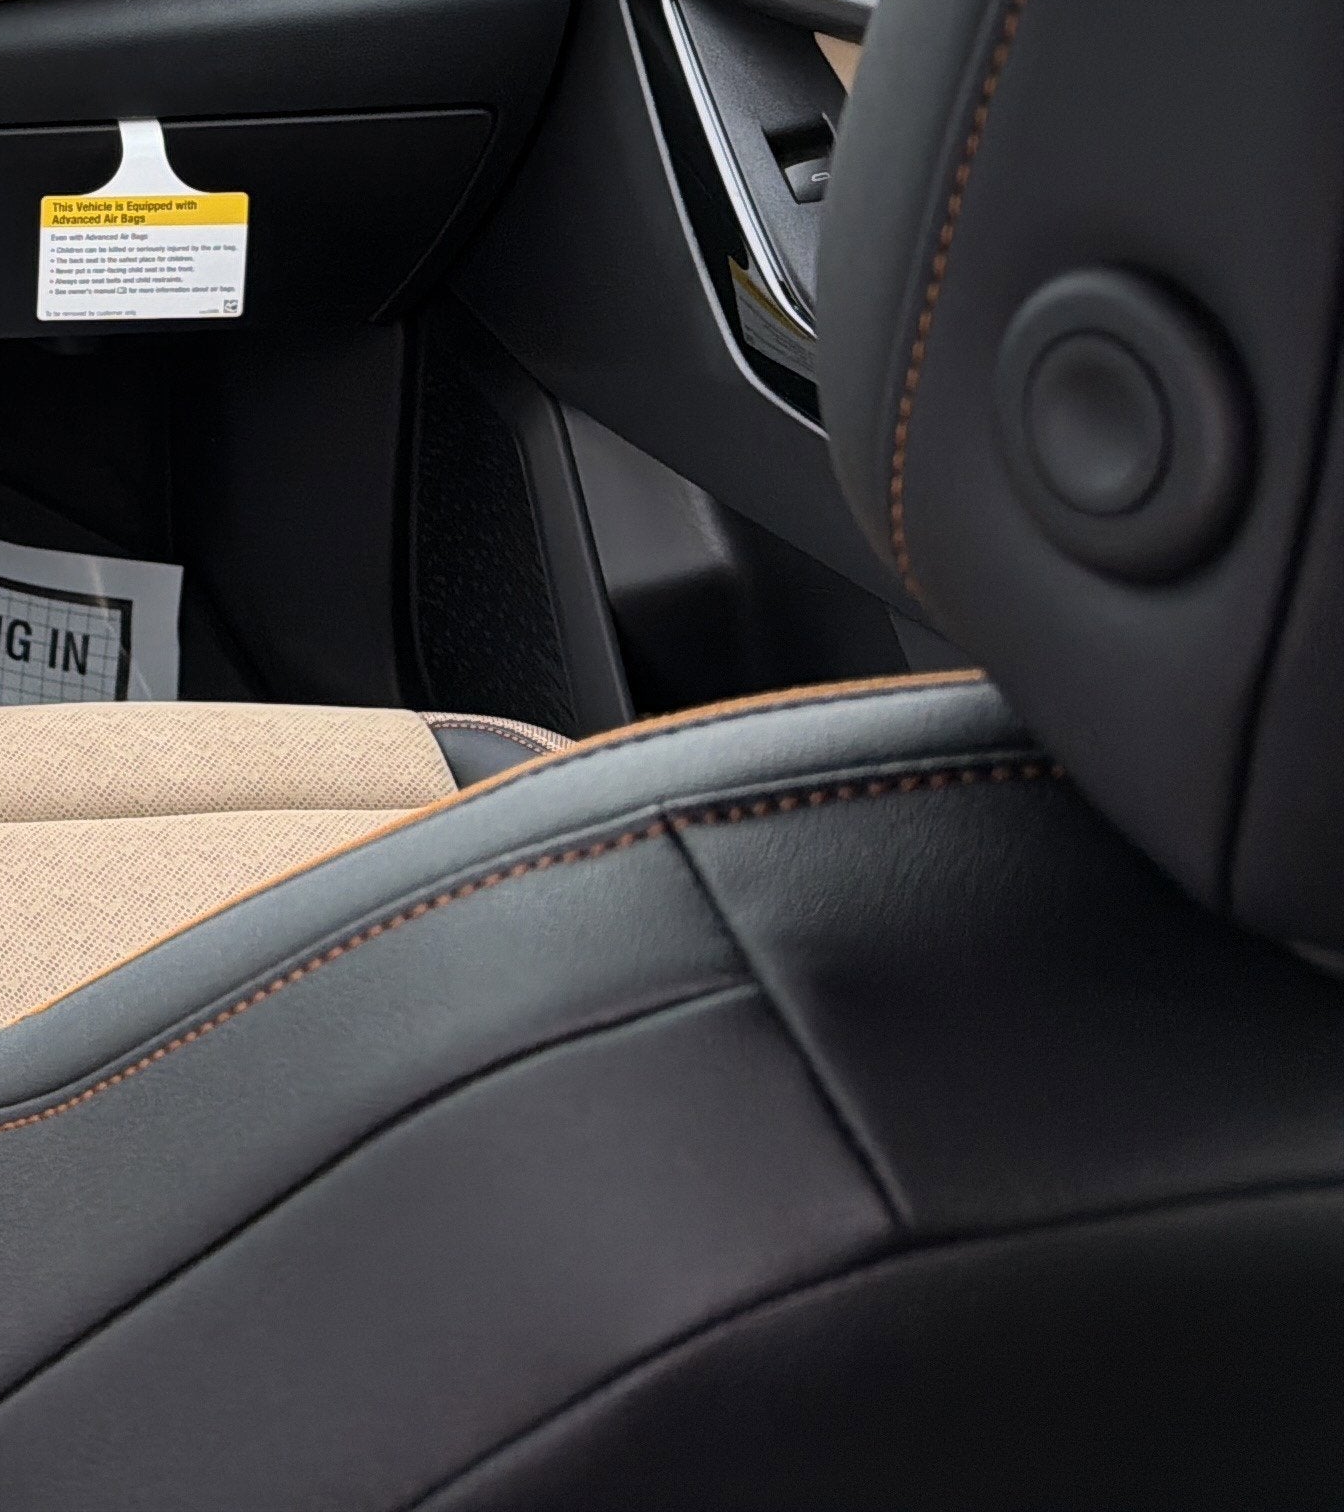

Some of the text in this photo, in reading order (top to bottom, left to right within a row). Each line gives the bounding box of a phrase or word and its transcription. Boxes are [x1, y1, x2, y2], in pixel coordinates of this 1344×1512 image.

[52, 200, 198, 213] This Vehicle is Equipped with
[52, 213, 146, 225] Advanced Air Bags
[85, 233, 119, 241] Advanced
[47, 628, 91, 676] IN
